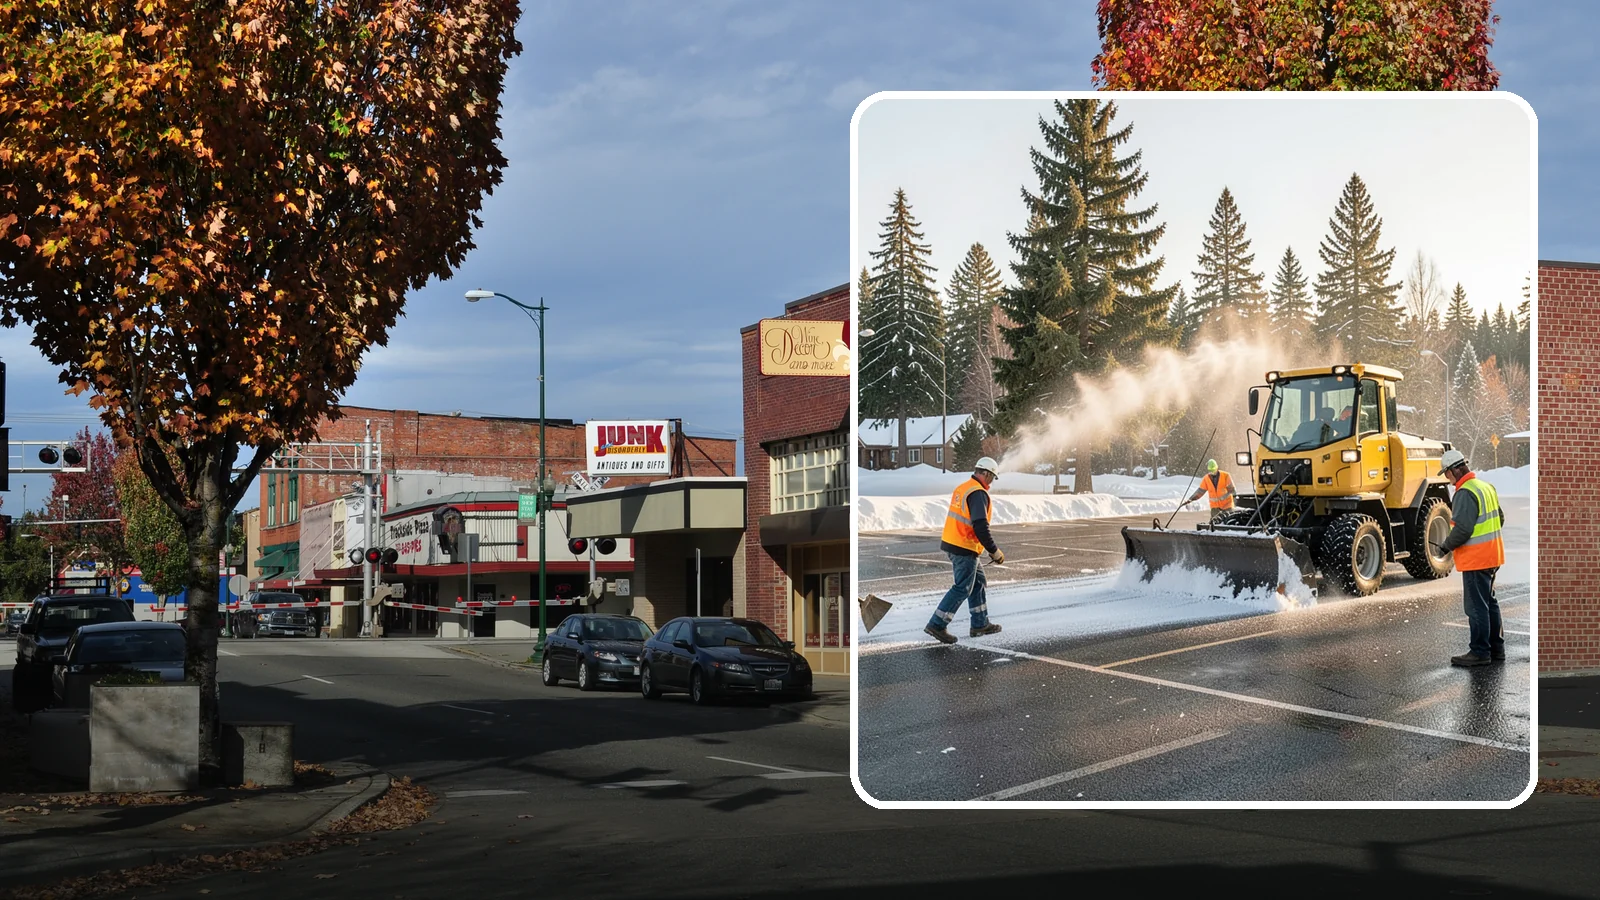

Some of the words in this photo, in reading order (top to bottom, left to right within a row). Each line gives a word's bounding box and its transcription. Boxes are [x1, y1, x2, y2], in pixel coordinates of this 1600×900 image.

[764, 328, 831, 365] Decor
[595, 425, 665, 457] JUNK
[607, 446, 646, 454] DISORDERLY
[596, 461, 628, 470] ANTIQUES
[631, 461, 644, 470] AND
[646, 460, 665, 469] GIFTS
[414, 519, 429, 535] Pizza
